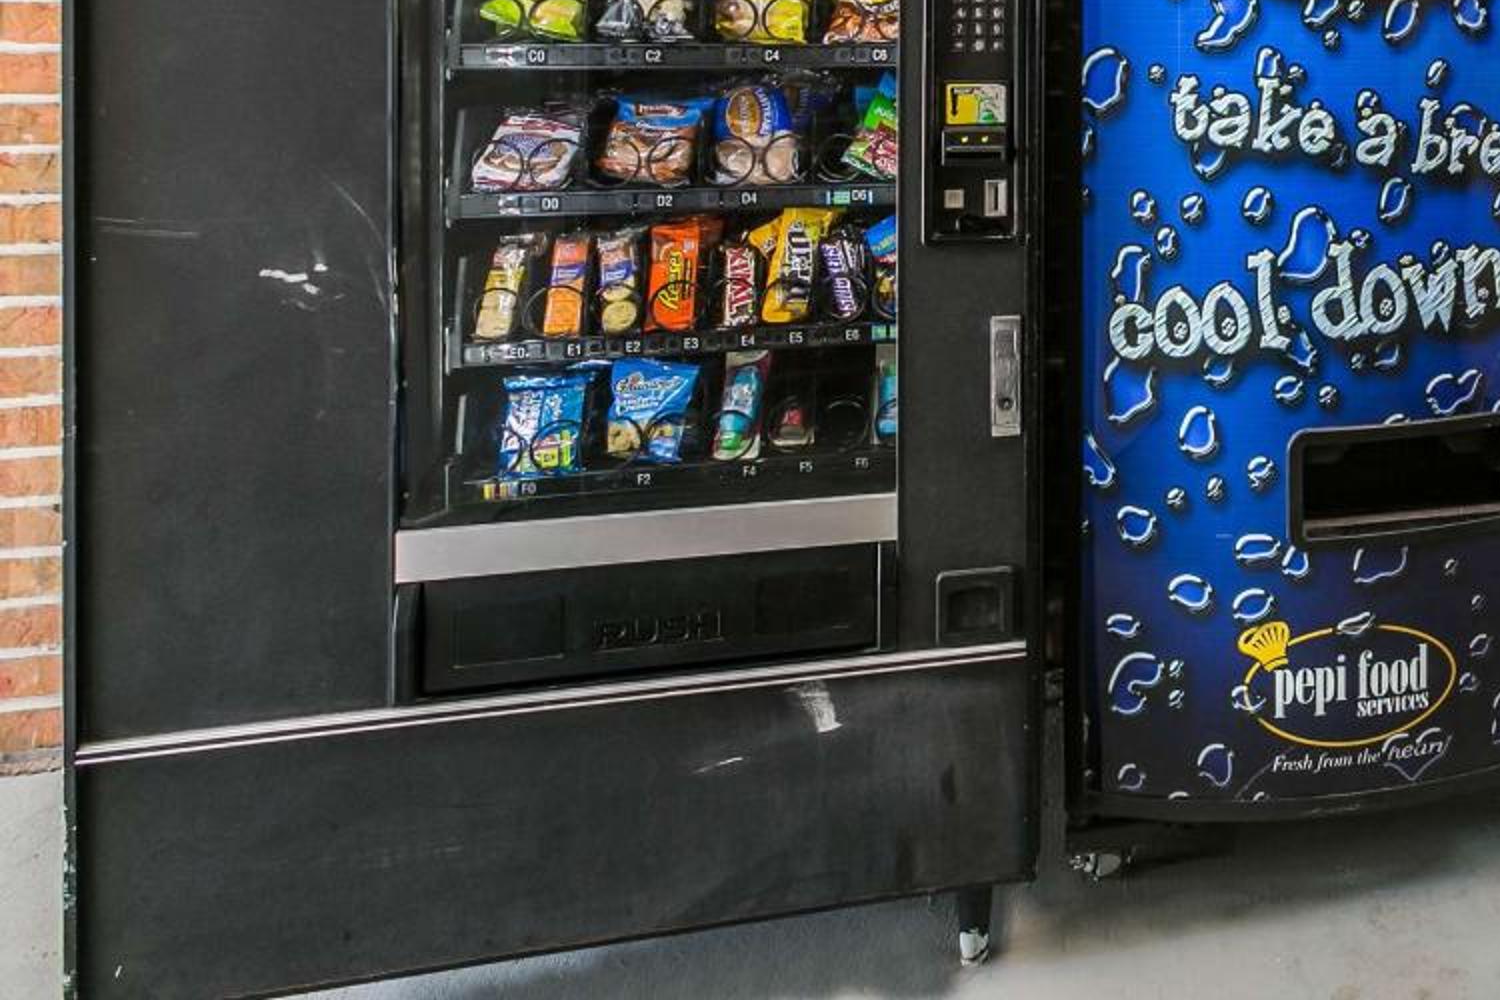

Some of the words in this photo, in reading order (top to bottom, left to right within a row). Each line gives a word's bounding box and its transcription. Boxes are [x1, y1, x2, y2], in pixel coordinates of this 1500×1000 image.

[528, 50, 545, 62] C0
[645, 49, 662, 62] C2
[764, 49, 780, 61] C4
[1171, 75, 1337, 154] take
[1356, 108, 1399, 167] a
[1109, 248, 1292, 360] cool
[625, 341, 640, 352] E2
[683, 337, 699, 349] E3
[741, 335, 755, 347] E4
[566, 343, 581, 355] E1
[638, 473, 651, 485] F2
[593, 611, 723, 650] PUSH
[1274, 654, 1348, 719] pepi
[1358, 643, 1428, 698] food
[1356, 692, 1429, 718] services
[1272, 754, 1313, 773] Fresh
[1314, 751, 1353, 773] from
[1356, 748, 1378, 766] the
